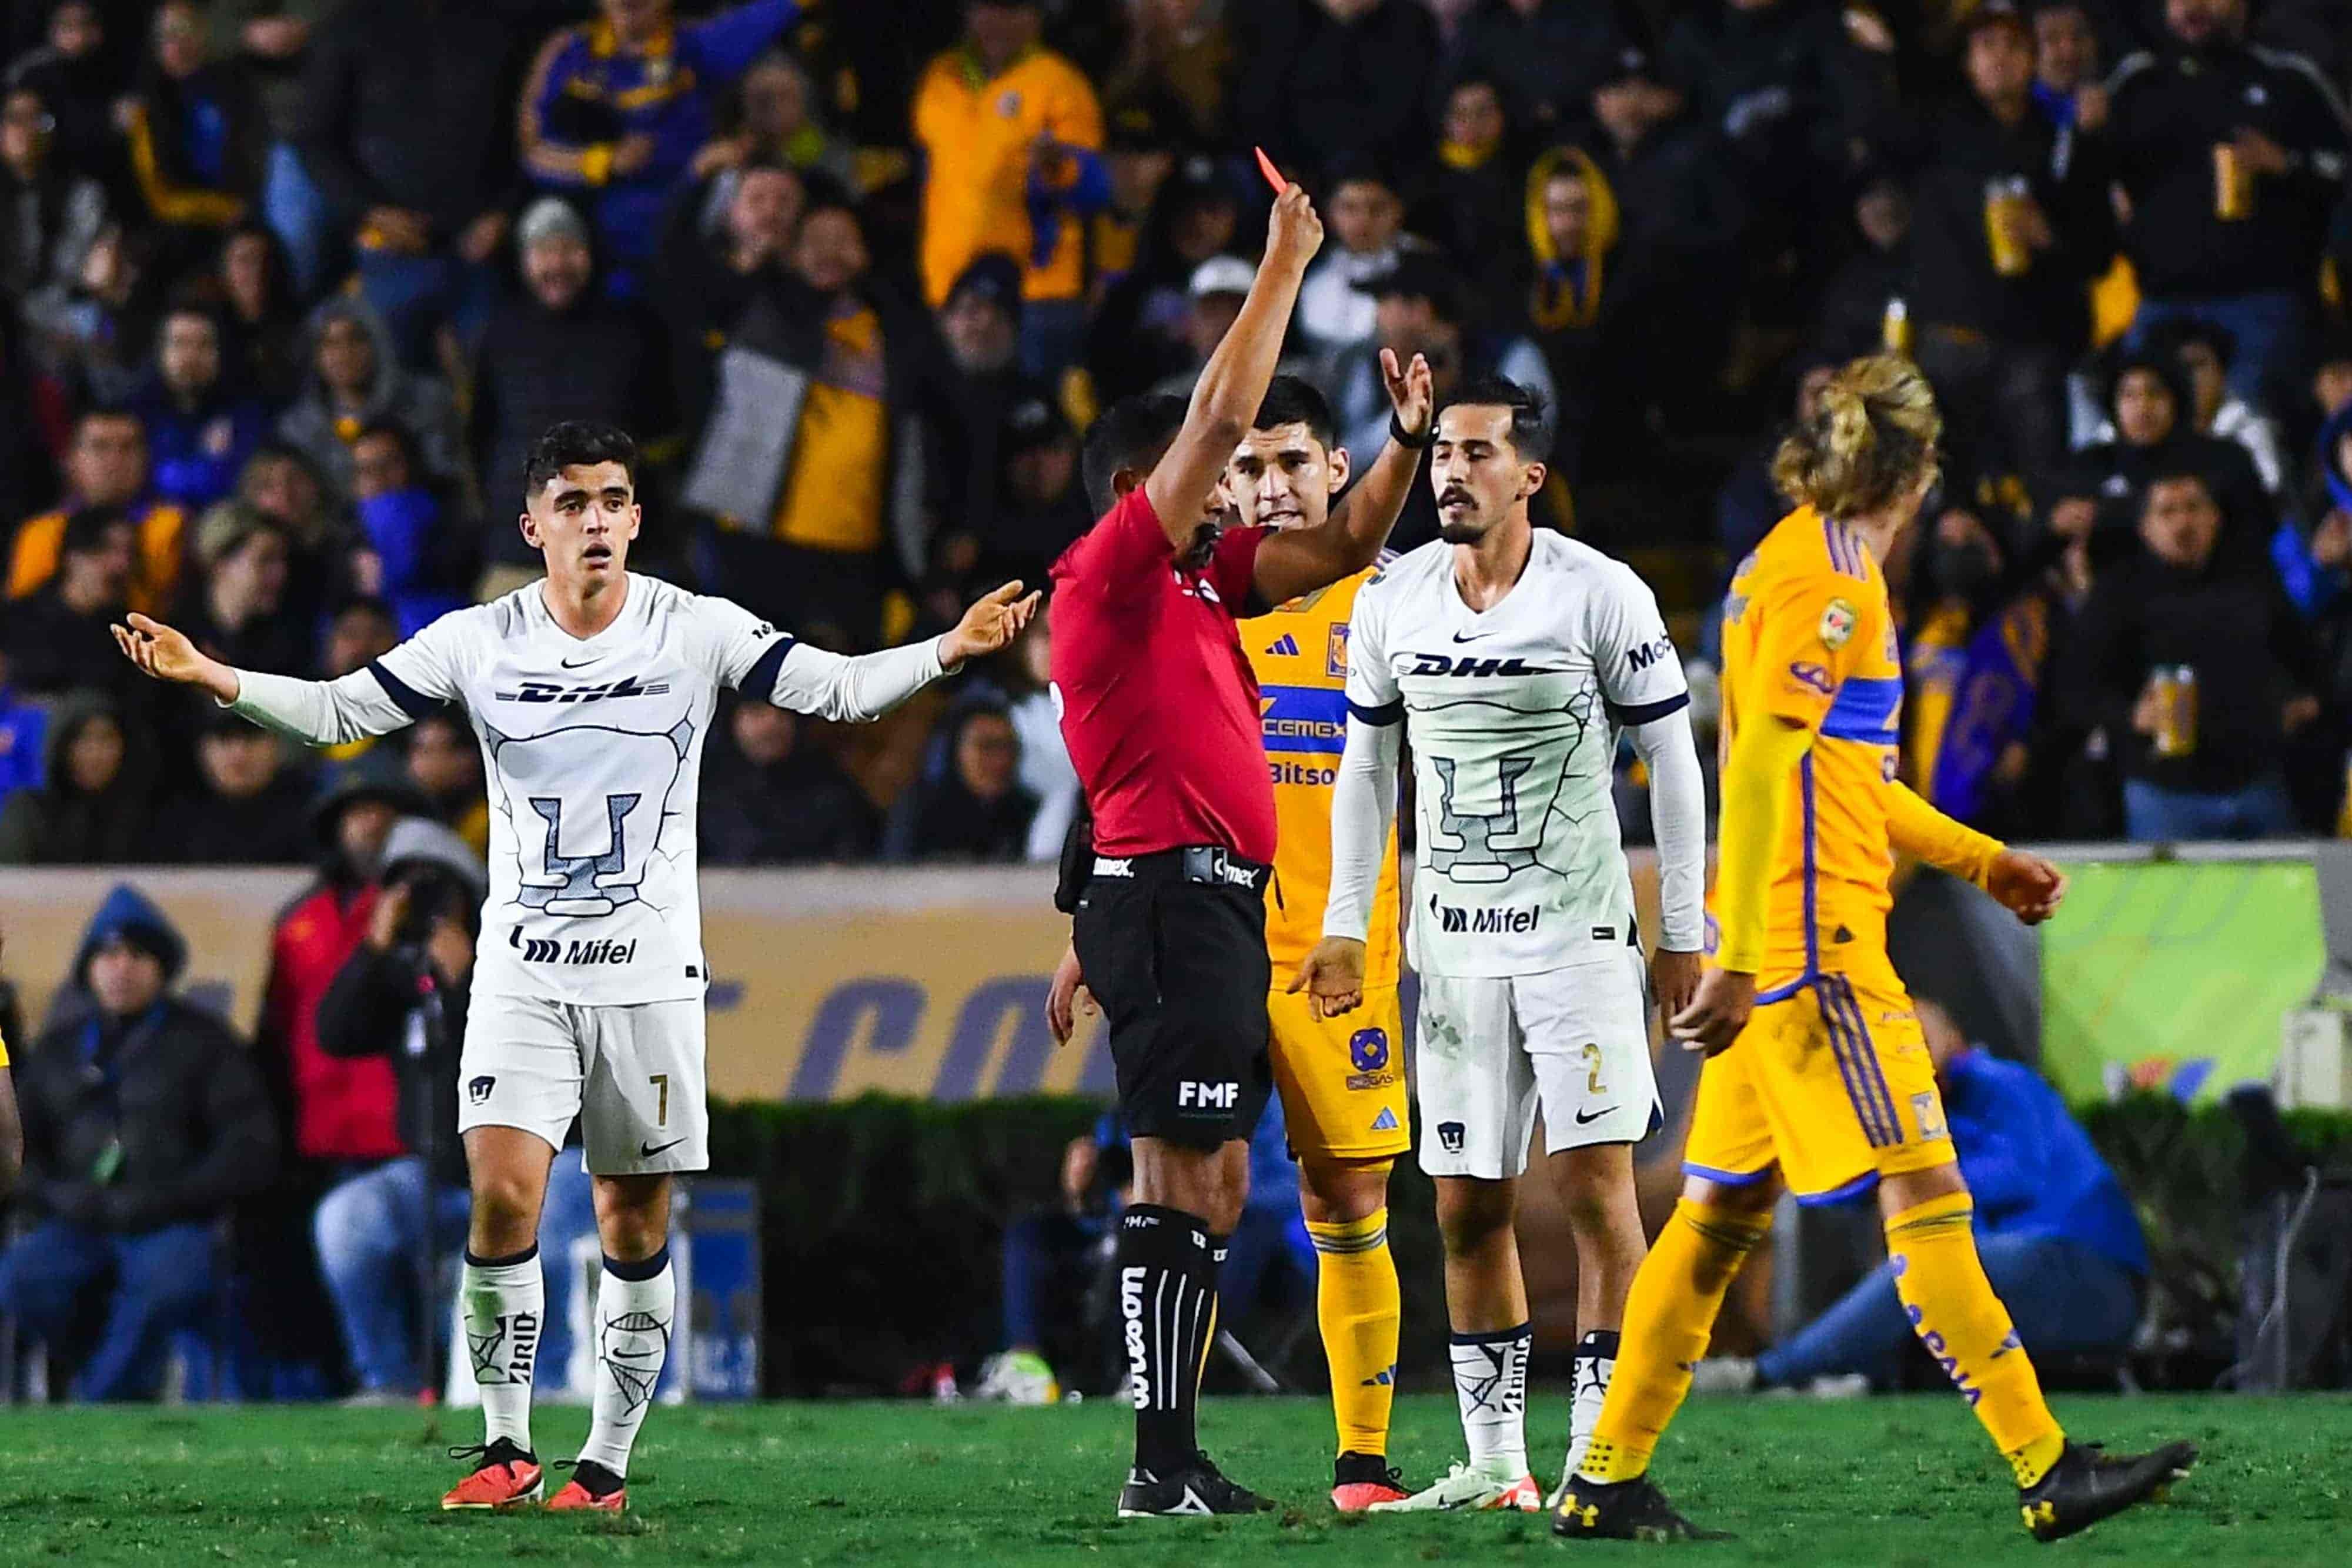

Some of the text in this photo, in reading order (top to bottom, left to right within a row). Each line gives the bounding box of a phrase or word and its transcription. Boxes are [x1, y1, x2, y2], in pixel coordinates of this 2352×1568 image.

[1409, 653, 1532, 677] DHL
[517, 675, 645, 703] DHL
[1261, 718, 1346, 738] CEMEX
[1268, 761, 1335, 785] Bitso
[1214, 857, 1259, 889] Cmex
[1472, 904, 1541, 933] Mifel
[563, 938, 637, 965] Mifel
[1582, 1042, 1607, 1095] 2
[1178, 1081, 1239, 1108] FMF
